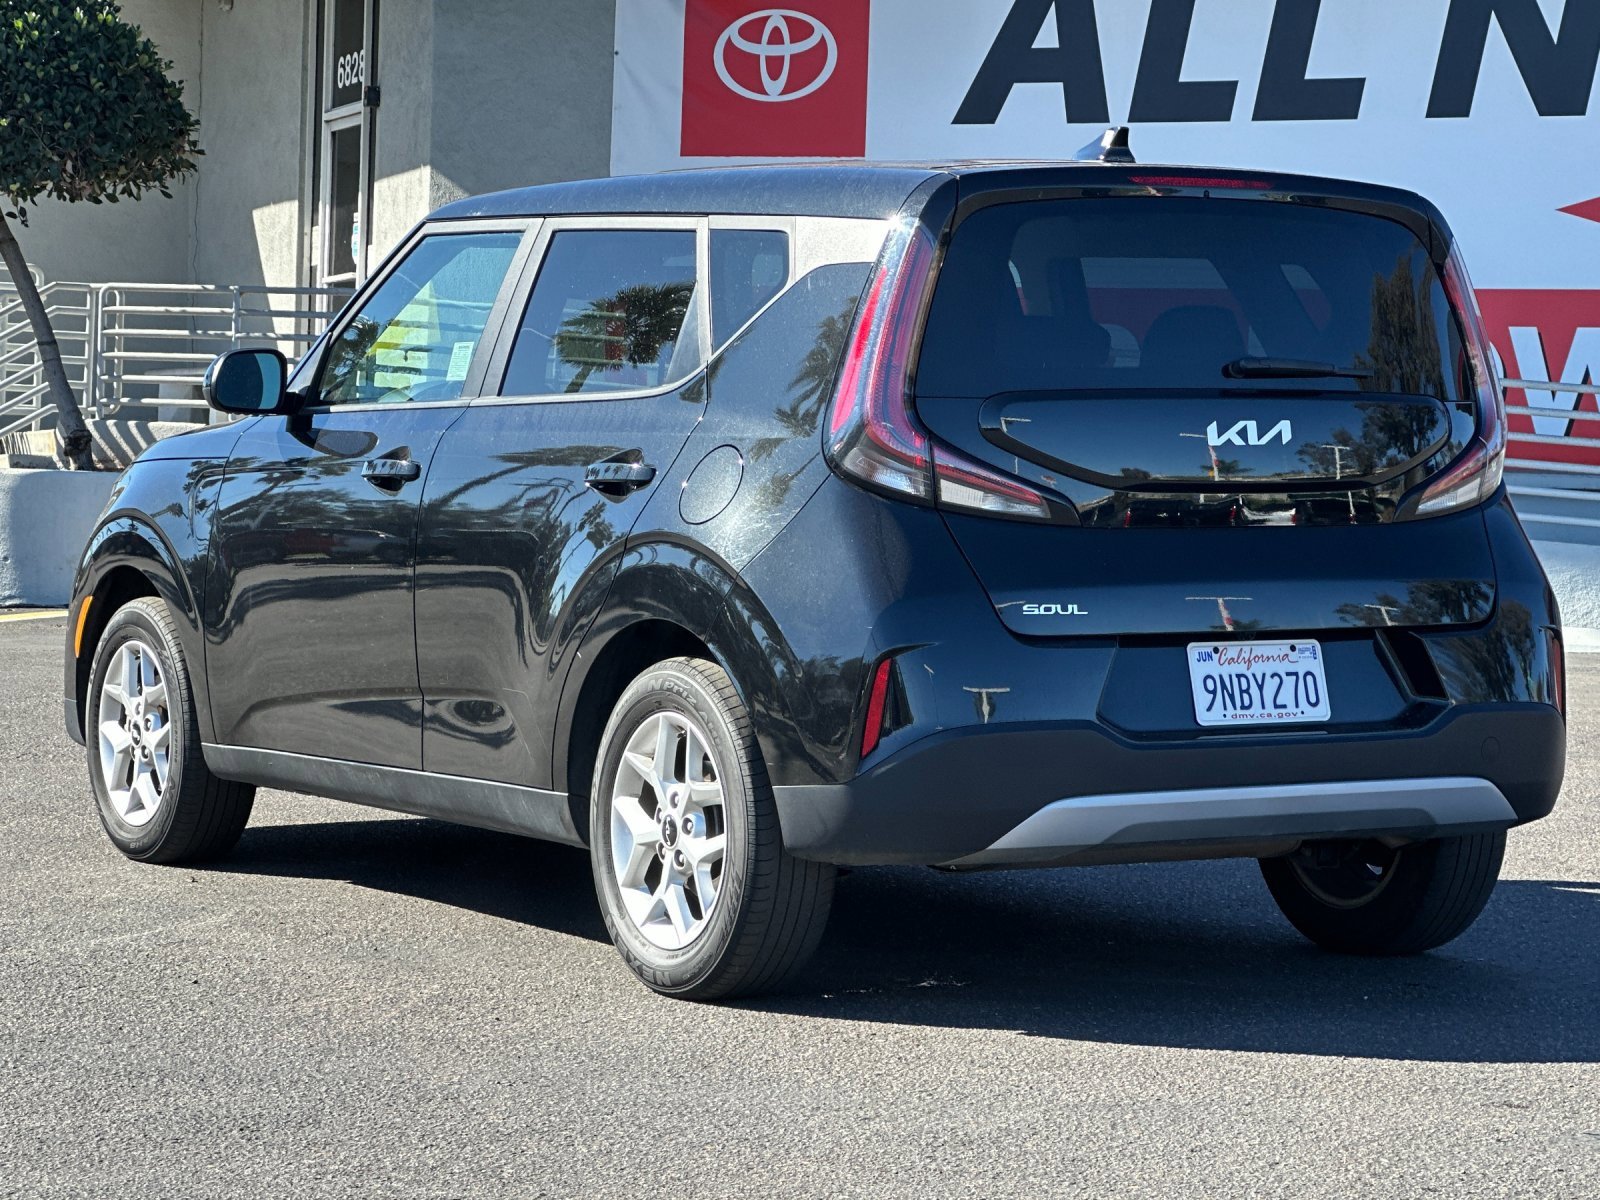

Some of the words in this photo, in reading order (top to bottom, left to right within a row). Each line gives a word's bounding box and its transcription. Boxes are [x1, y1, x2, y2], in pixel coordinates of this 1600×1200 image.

[951, 0, 1367, 124] ALL
[1206, 419, 1292, 446] KIA
[1022, 603, 1089, 615] SOUL
[1196, 650, 1214, 662] JUN
[1218, 647, 1299, 671] California
[1202, 670, 1321, 713] 9NBY270
[1231, 710, 1299, 720] dmv.ca.gov
